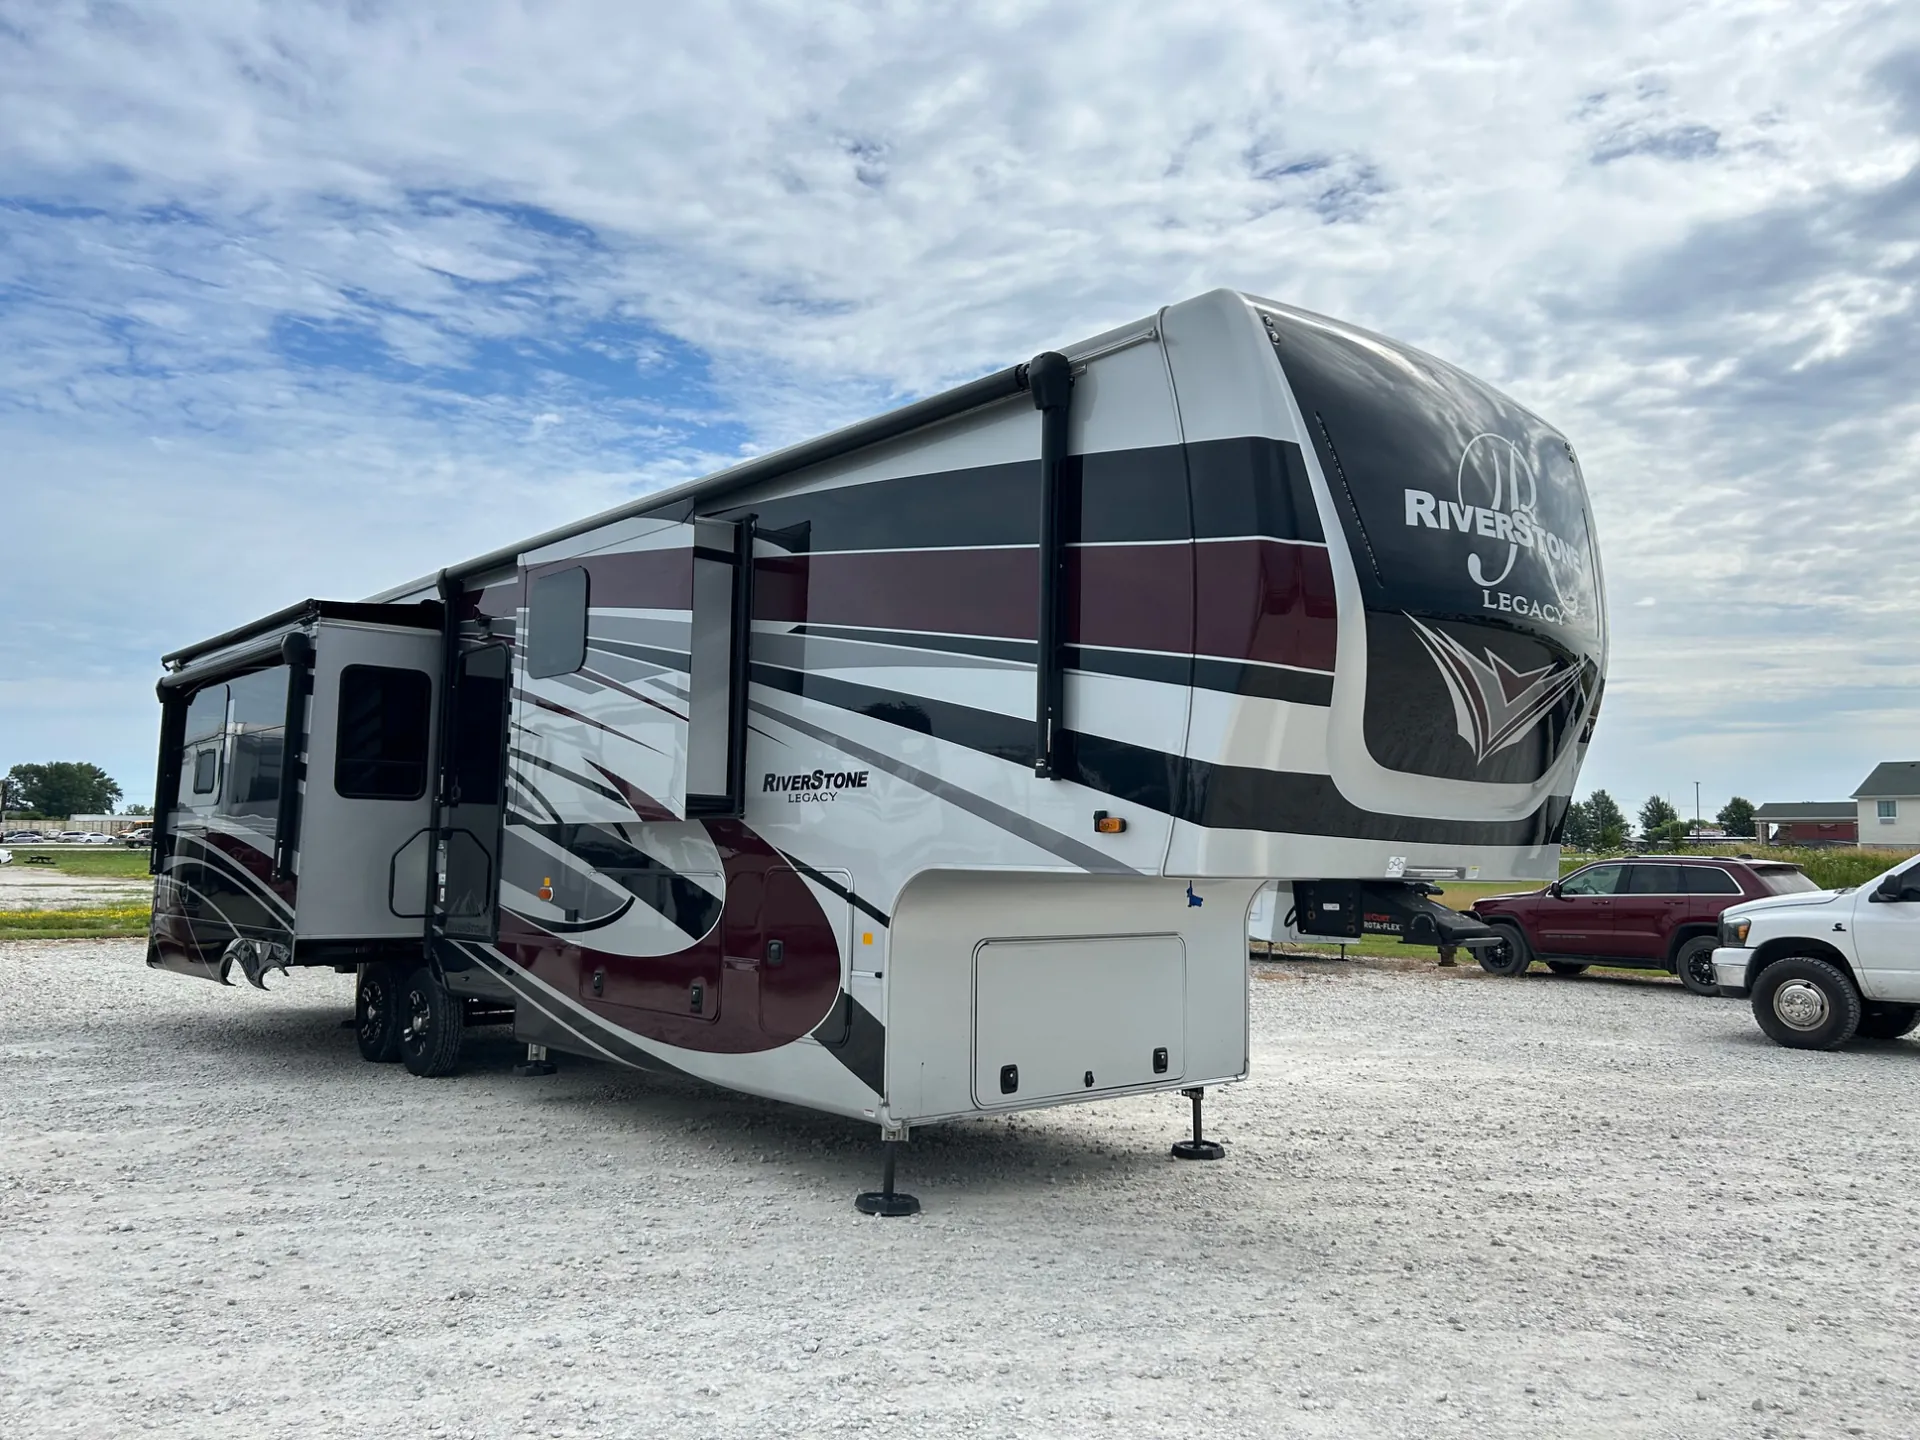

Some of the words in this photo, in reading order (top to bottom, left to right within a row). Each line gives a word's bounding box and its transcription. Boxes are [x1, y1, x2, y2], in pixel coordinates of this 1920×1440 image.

[1404, 489, 1582, 575] RIVERSTONE
[1482, 589, 1566, 626] LEGACY
[762, 769, 869, 792] RIVERSTONE
[788, 791, 838, 803] LEGACY
[1363, 921, 1400, 931] ROTA-FLEX
